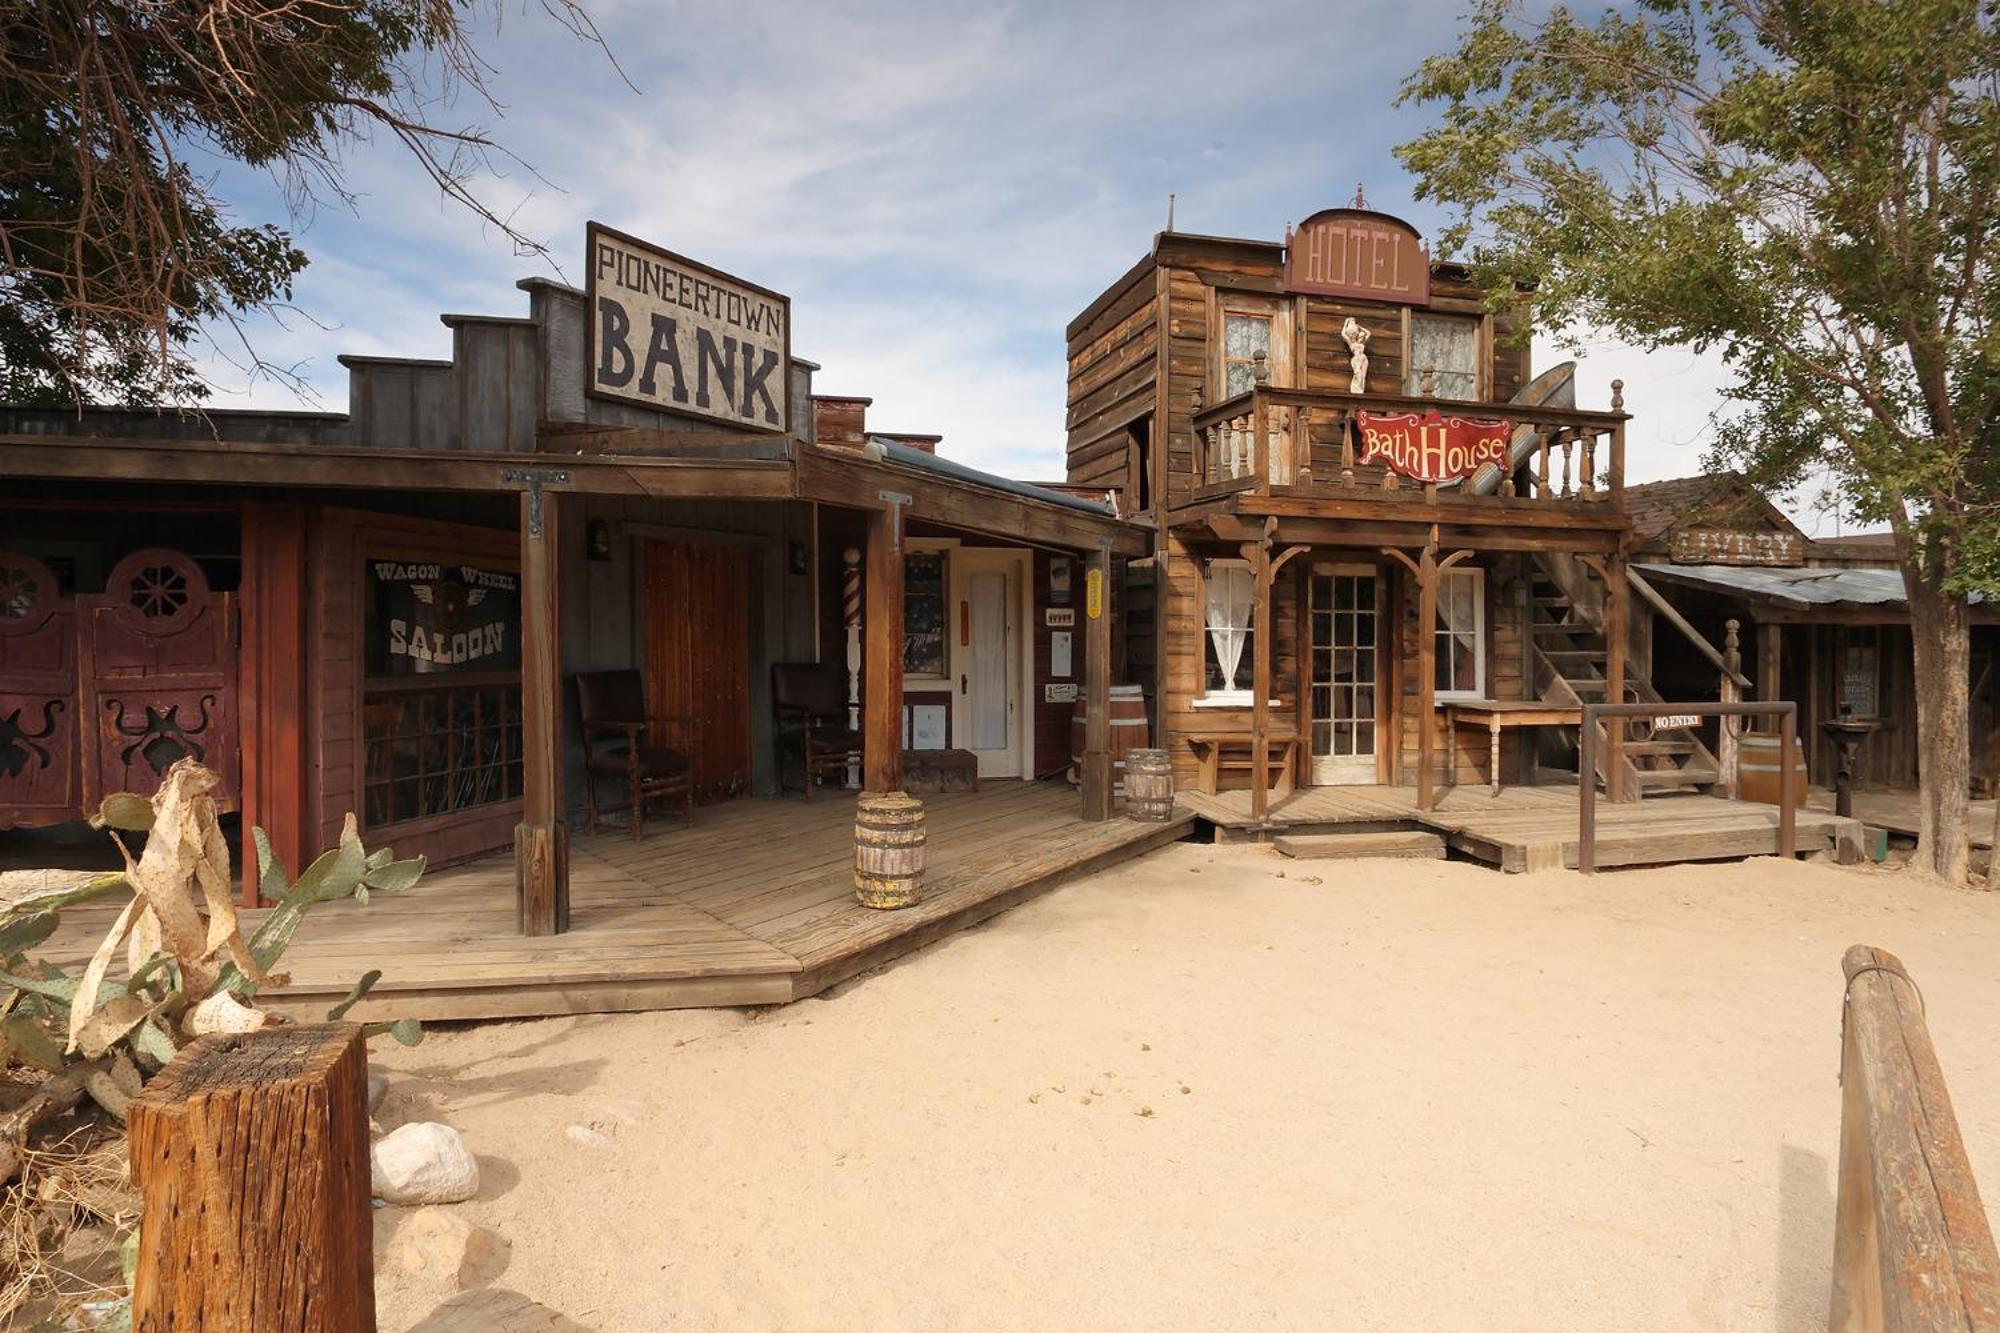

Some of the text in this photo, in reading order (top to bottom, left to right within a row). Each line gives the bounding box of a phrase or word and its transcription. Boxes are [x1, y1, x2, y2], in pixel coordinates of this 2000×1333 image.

[1305, 225, 1409, 292] HOTEL
[597, 243, 781, 338] PIONEERTOWN
[597, 295, 780, 425] BANK
[374, 562, 516, 591] WAGON WHEEL
[389, 618, 505, 665] SALOON
[1655, 716, 1669, 729] NO
